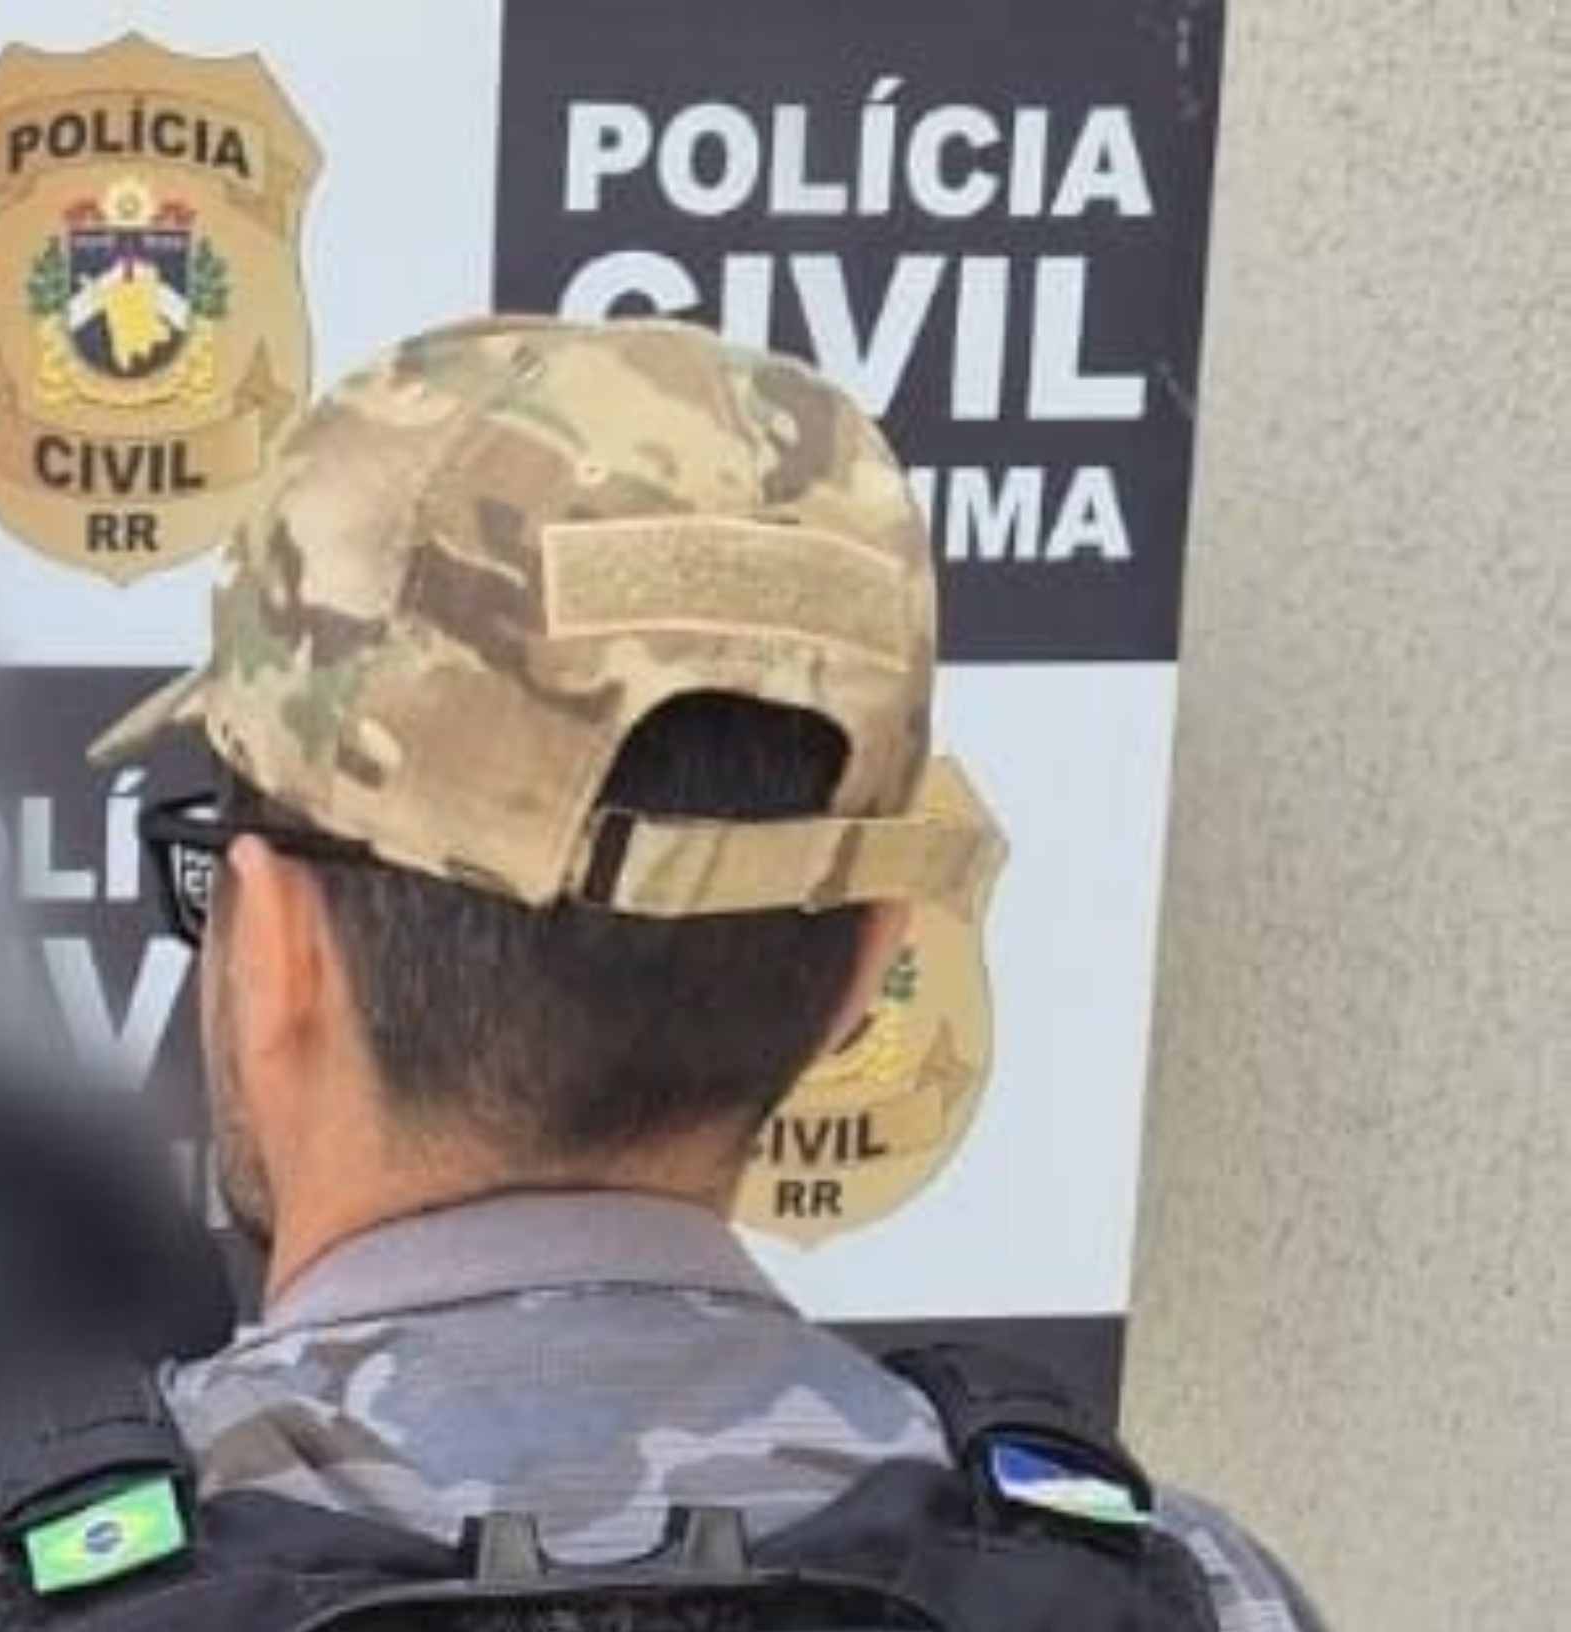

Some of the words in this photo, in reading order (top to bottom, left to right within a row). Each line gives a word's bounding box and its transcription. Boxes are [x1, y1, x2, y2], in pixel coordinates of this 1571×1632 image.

[7, 97, 252, 178] POLÍCIA
[563, 76, 1155, 219] POLÍCIA
[32, 435, 207, 493] CIVIL
[86, 514, 158, 551] RR
[754, 1112, 886, 1166] IVIL
[775, 1179, 843, 1218] RR
